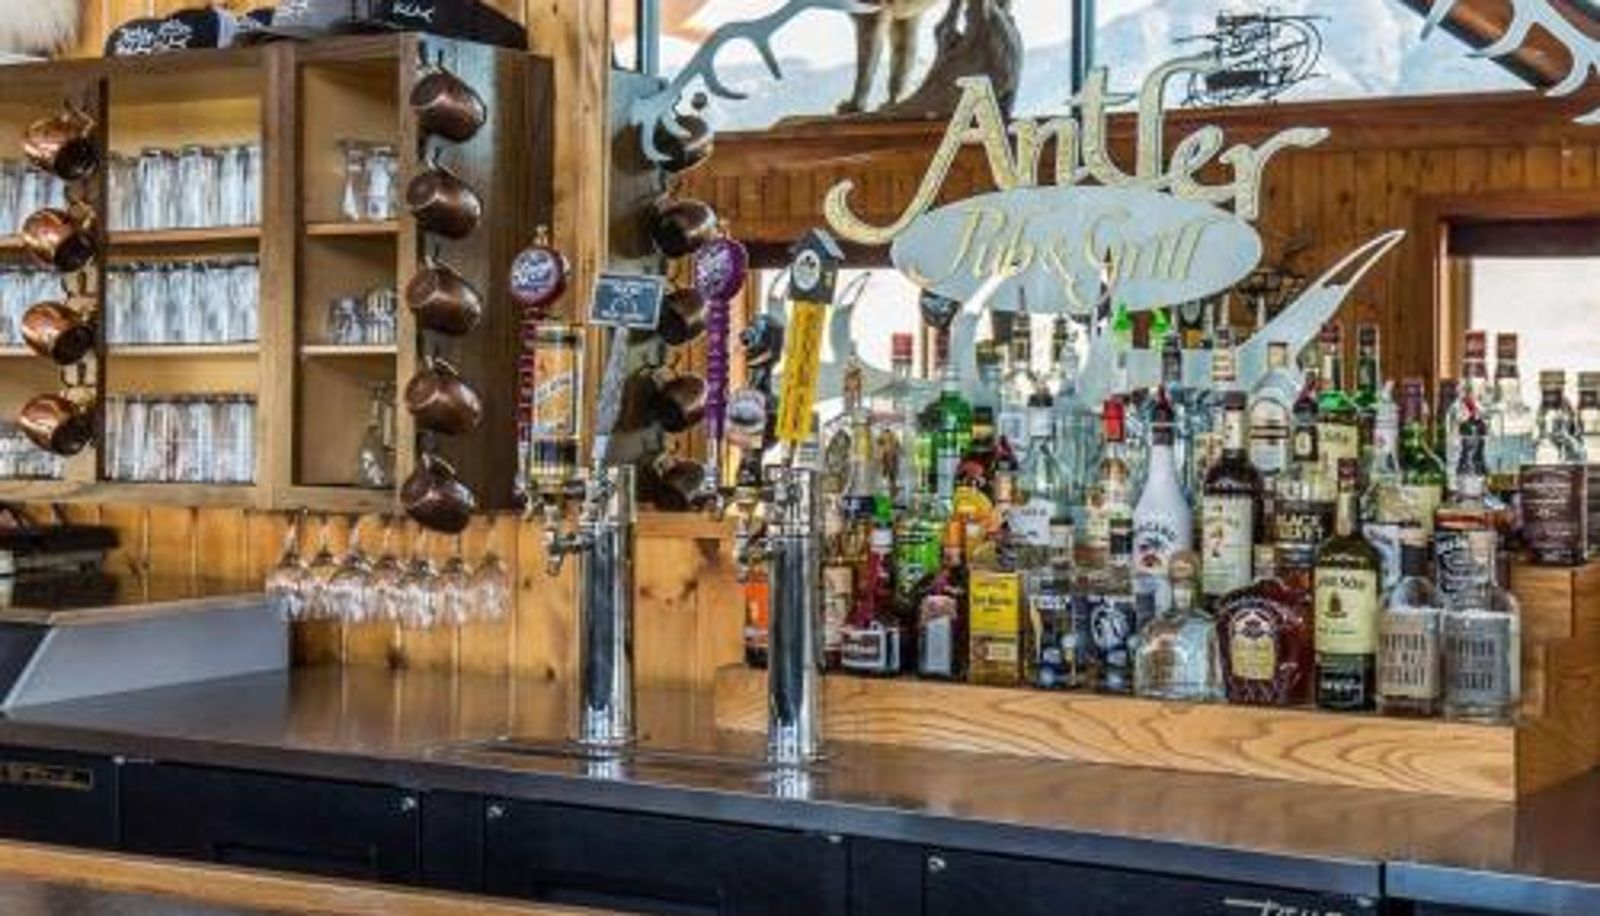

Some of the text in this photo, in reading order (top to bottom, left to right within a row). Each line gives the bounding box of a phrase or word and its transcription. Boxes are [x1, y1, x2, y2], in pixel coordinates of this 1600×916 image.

[825, 52, 1330, 244] Antler
[948, 204, 1034, 281] Pub
[1083, 205, 1212, 302] Grill
